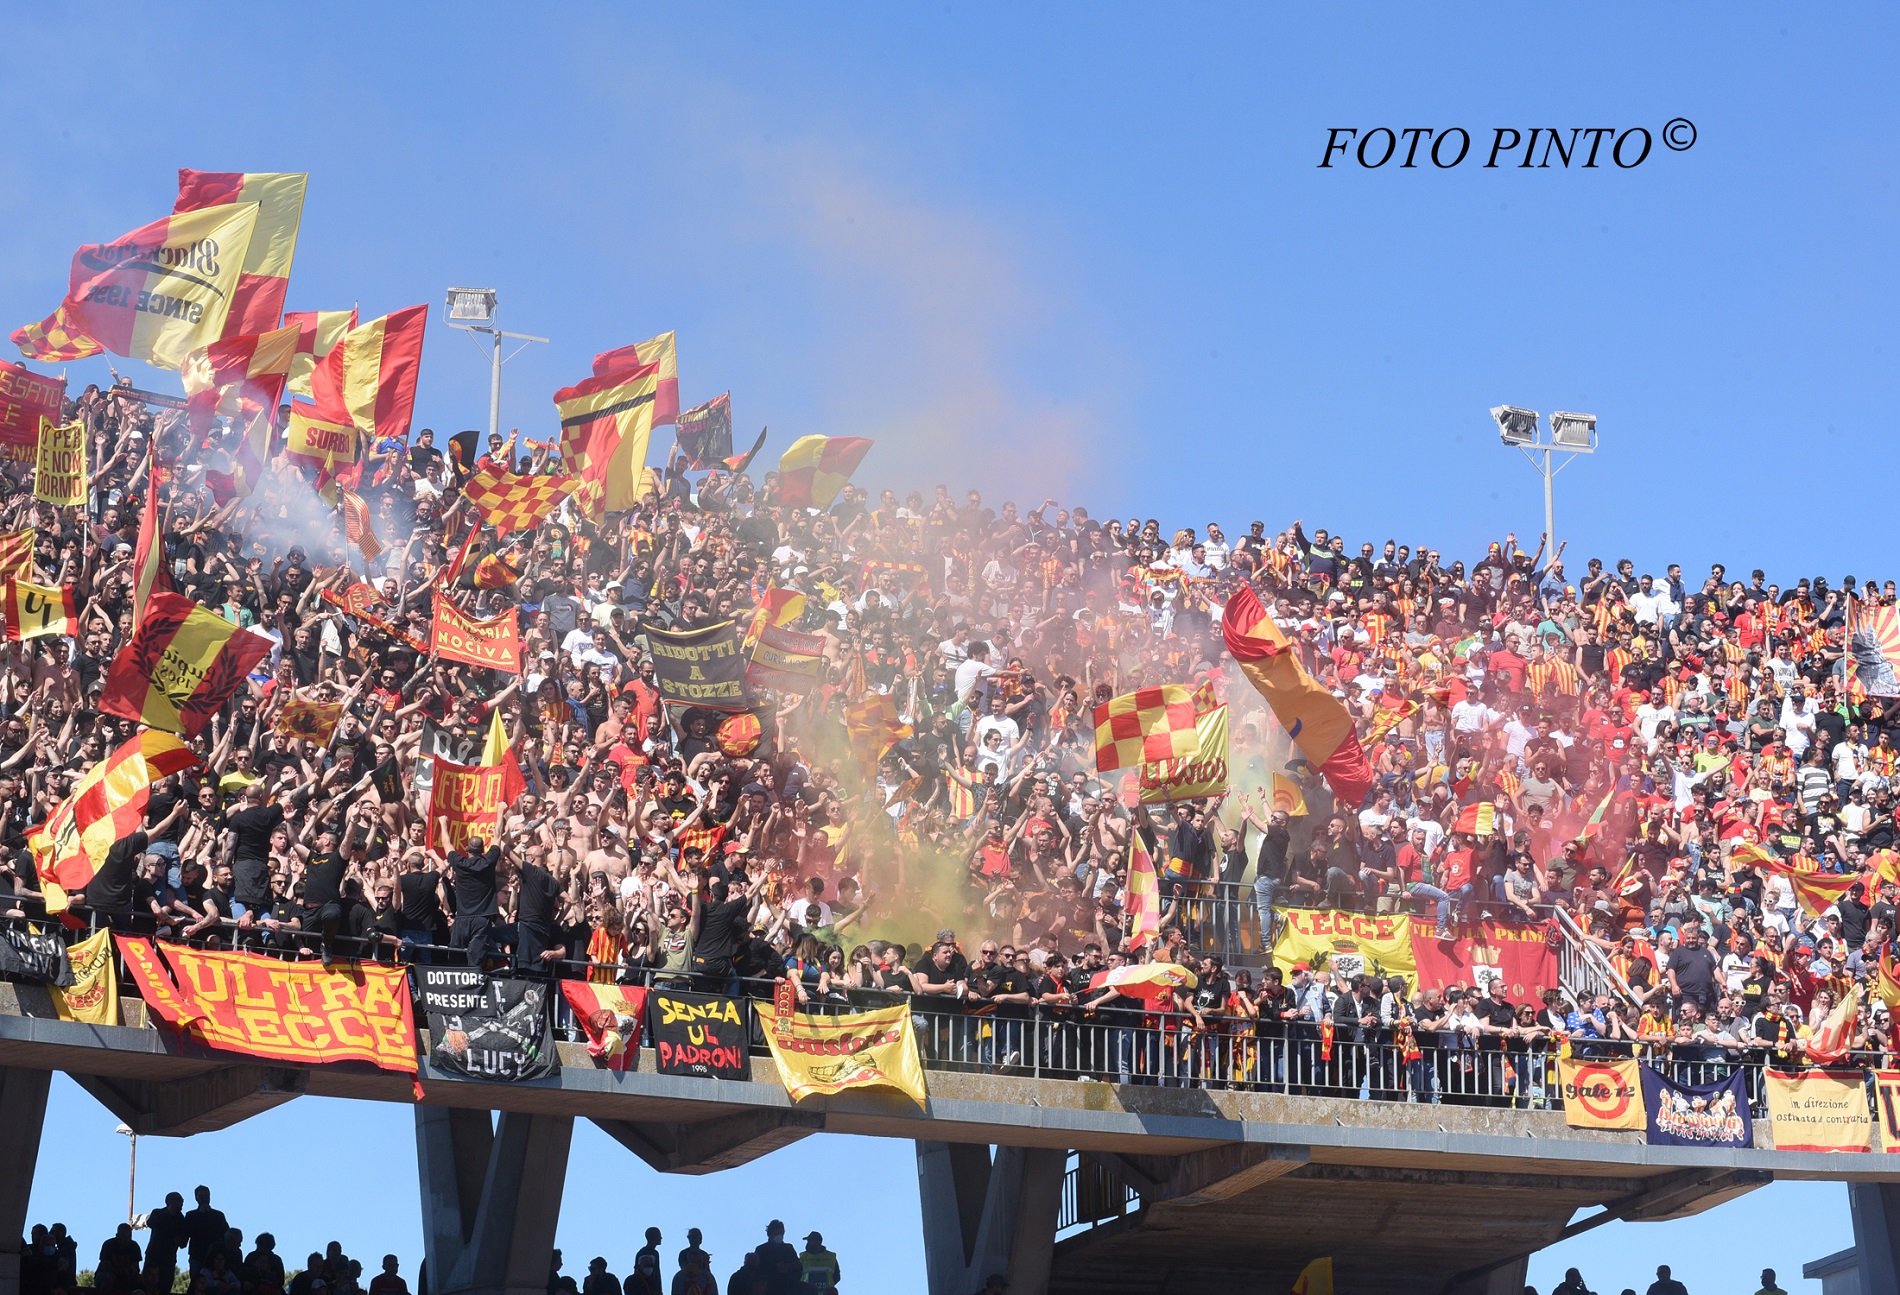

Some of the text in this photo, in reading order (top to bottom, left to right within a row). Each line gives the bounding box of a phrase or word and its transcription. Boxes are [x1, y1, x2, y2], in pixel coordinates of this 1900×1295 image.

[53, 428, 81, 449] PER
[52, 450, 82, 475] NON
[437, 630, 513, 660] NOCIVA
[651, 639, 736, 662] RIDOTTI
[689, 665, 705, 681] A
[662, 680, 743, 699] STOZZE
[1286, 911, 1395, 941] LECCE
[427, 971, 485, 986] DOTTORE
[426, 992, 489, 1009] PRESENTE
[779, 984, 790, 1016] ECCE
[657, 997, 741, 1026] SENZA
[193, 994, 414, 1054] LECCE
[687, 1024, 719, 1046] UL
[467, 1048, 525, 1077] LUCY
[659, 1041, 742, 1070] PADRONI
[1566, 1083, 1635, 1100] gate 12
[1804, 1096, 1849, 1109] direzione
[1776, 1112, 1816, 1123] ostinata
[1826, 1113, 1869, 1124] contraria
